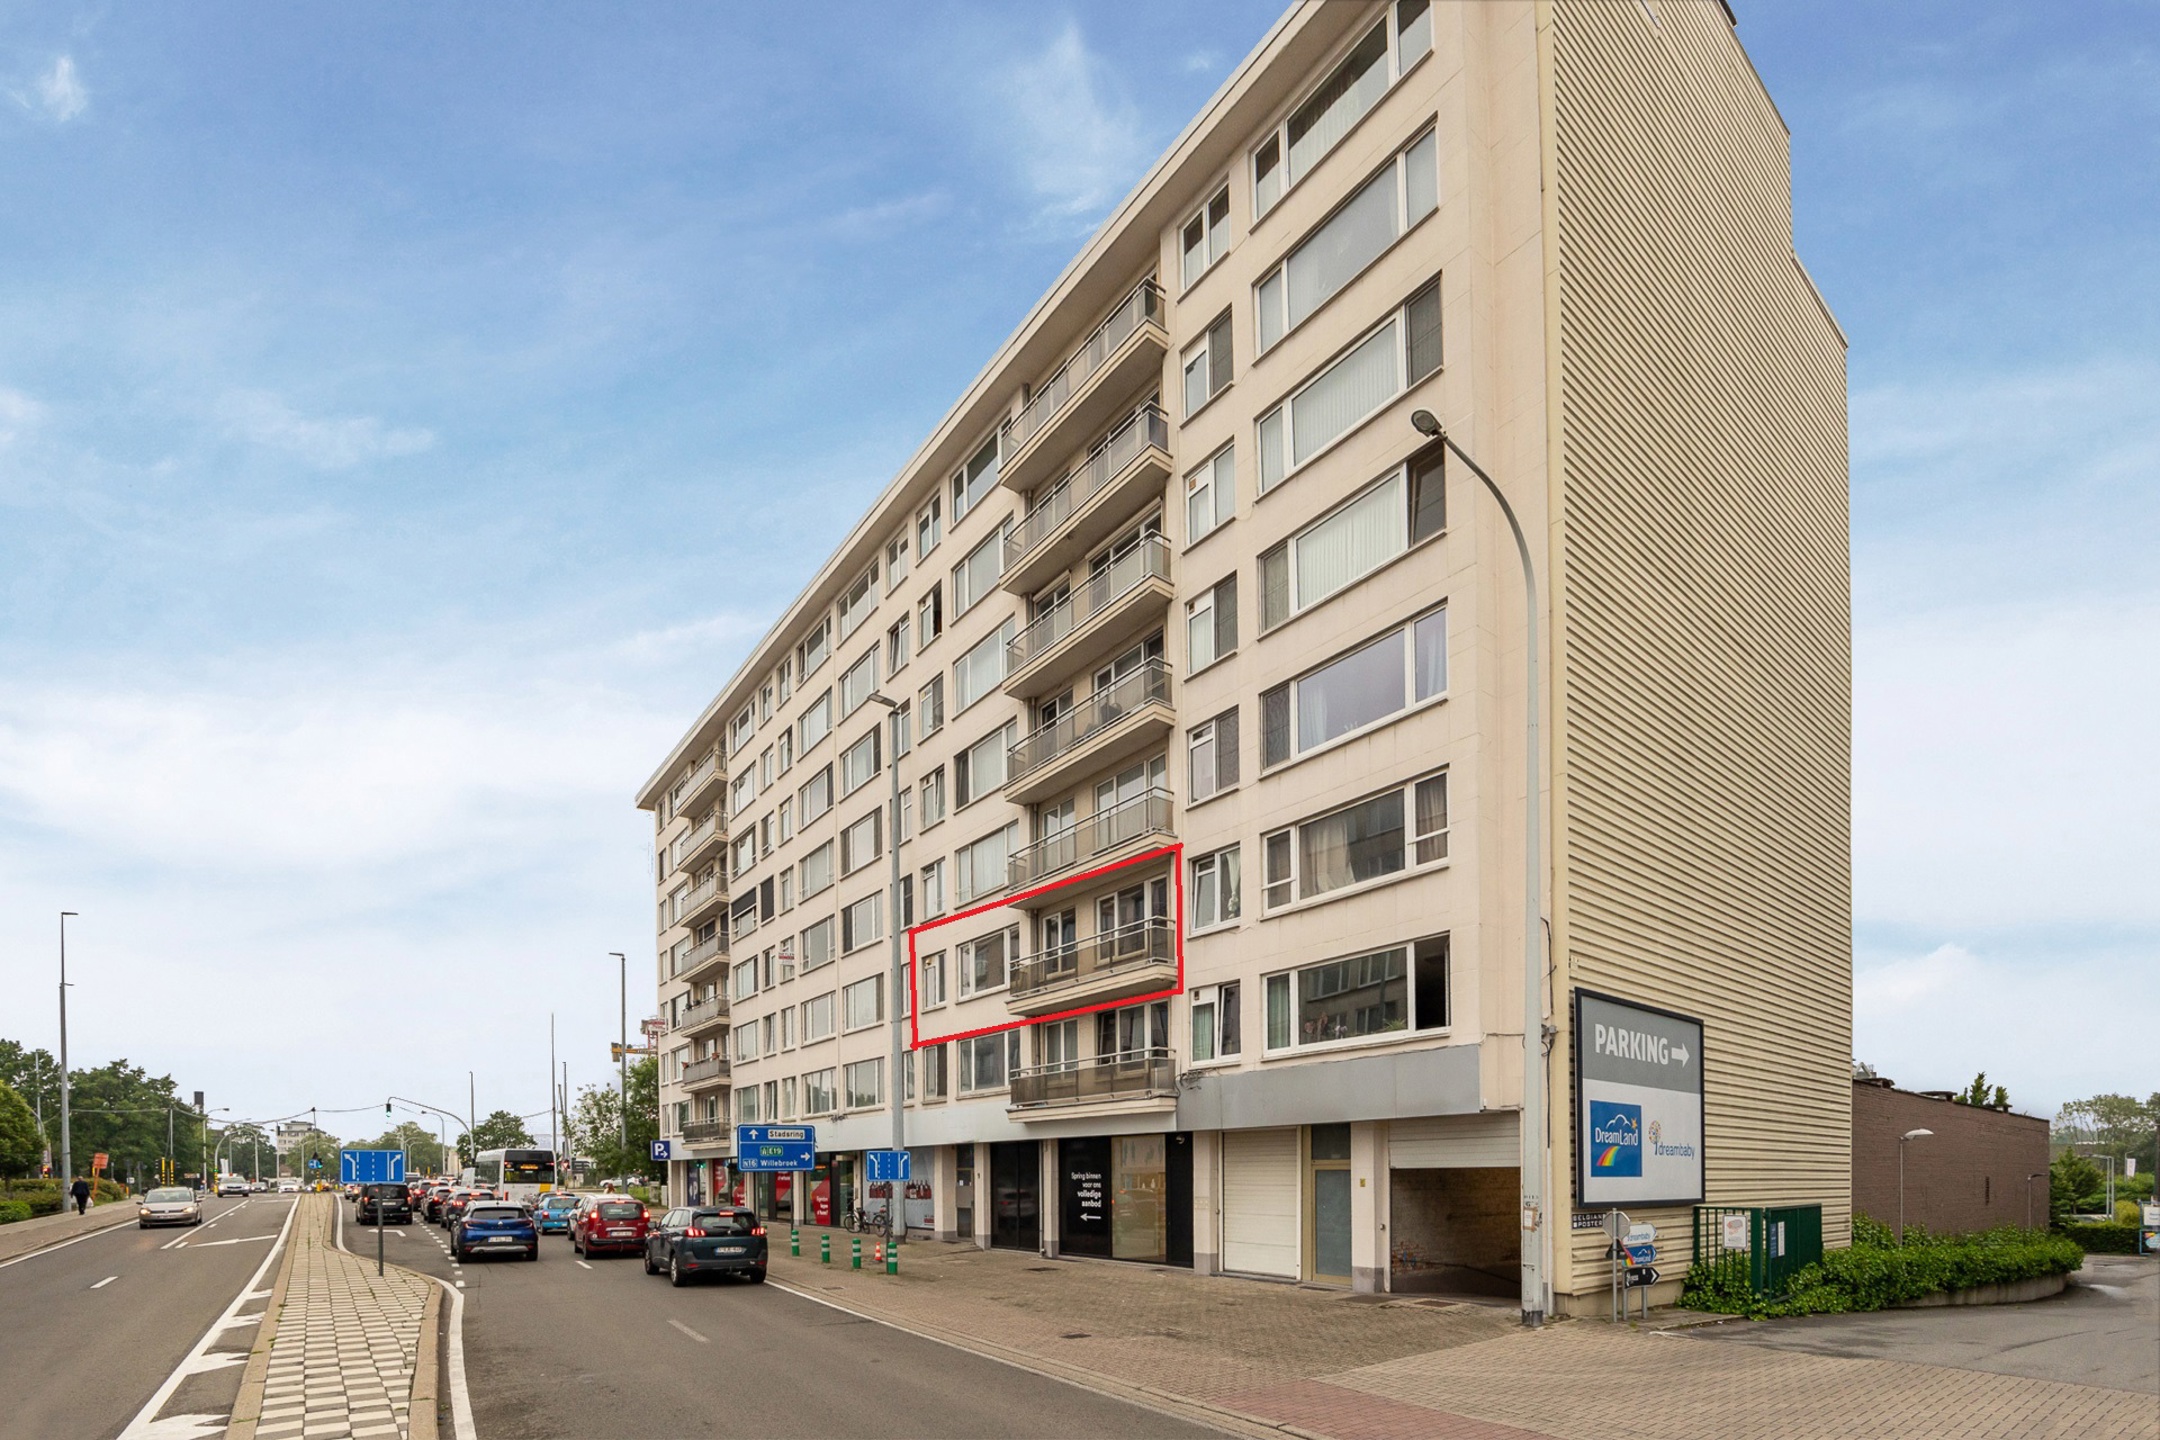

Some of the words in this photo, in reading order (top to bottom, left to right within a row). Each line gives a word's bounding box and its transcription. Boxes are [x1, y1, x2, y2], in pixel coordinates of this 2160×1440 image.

[1594, 1023, 1669, 1065] PARKING
[769, 1130, 804, 1139] Stadsring
[1595, 1127, 1638, 1146] DreamLand
[769, 1147, 782, 1155] E19
[1658, 1142, 1696, 1161] dreambaby
[760, 1159, 798, 1167] Willebroek
[1071, 1171, 1086, 1181] Spring
[1086, 1171, 1102, 1180] binnen
[1077, 1189, 1102, 1199] volledige
[1081, 1199, 1102, 1207] aanbod
[1577, 1220, 1603, 1228] POSTER
